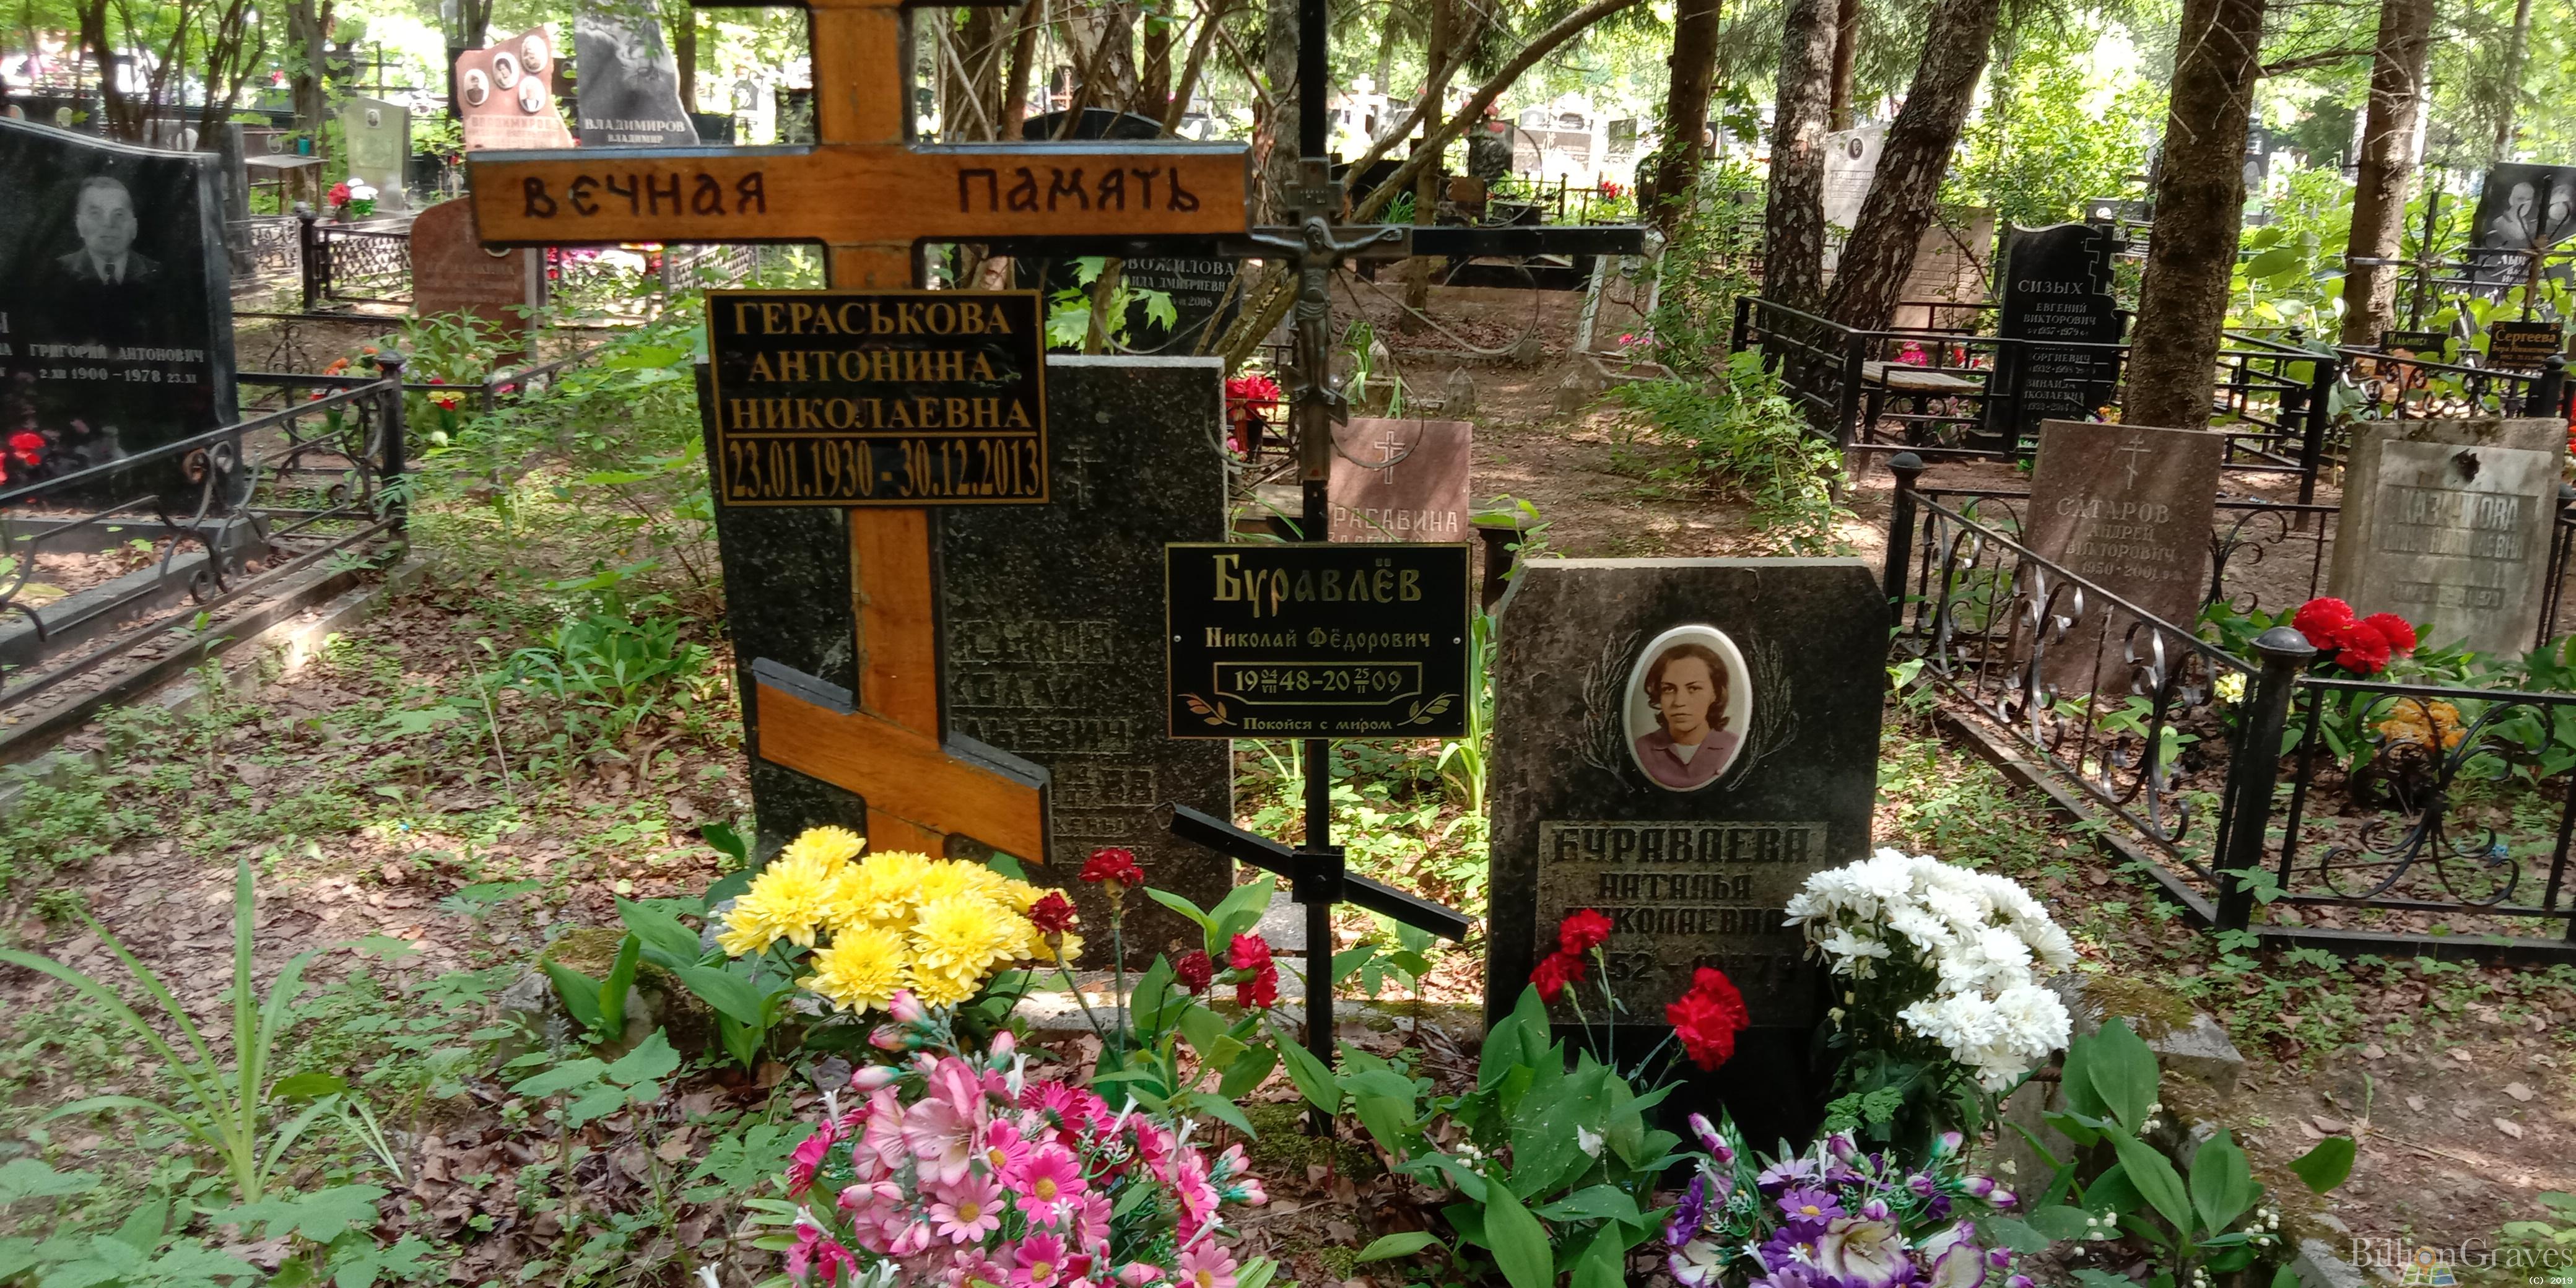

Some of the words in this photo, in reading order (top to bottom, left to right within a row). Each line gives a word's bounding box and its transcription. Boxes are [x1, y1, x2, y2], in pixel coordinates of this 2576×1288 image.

[585, 119, 685, 132] ВЛАДИМИРОВ
[607, 134, 664, 144] ВЛАДИМИР
[1120, 258, 1234, 276] ВОЖИЛОВА
[1159, 277, 1230, 293] ДМИТРИЕВН
[2017, 279, 2083, 294] СИЗЫХ
[2035, 302, 2087, 313] ЕВГЕНИЙ
[733, 302, 1012, 335] ГЕРАСЬКОВА
[2023, 314, 2097, 326] ВИКТОРОВИЧ
[2496, 329, 2557, 345] Сергеева
[30, 343, 108, 359] ГРИГОРИЙ
[117, 347, 204, 362] АНТОНОВИЧ
[2030, 352, 2091, 363] ОРГИЕВИЧ
[72, 368, 108, 380] 1900
[124, 370, 161, 382] 1978
[748, 350, 996, 383] АНТОНИНА
[730, 398, 1032, 430] НИКОЛАЕВНА
[729, 440, 874, 498] 23.01.1930
[900, 438, 1039, 496] 30.12.2013
[1333, 507, 1458, 533] РАСАВИНА
[2056, 498, 2170, 524] САТАРОВ
[2087, 523, 2156, 542] АНДРЕЙ
[2065, 542, 2175, 562] ВИКТОРОВИЧ
[1212, 554, 1422, 619] Буравлёв
[1205, 627, 1297, 648] Николай
[1307, 626, 1430, 653] Фёдорович
[1243, 716, 1312, 730] Покойся
[1320, 721, 1328, 730] с
[1336, 720, 1393, 733] миром
[1552, 828, 1810, 864] БУРАВЛЕВА
[1599, 872, 1752, 900] НАТАЛЬЯ
[1566, 907, 1786, 934] КОЛАЕВНА
